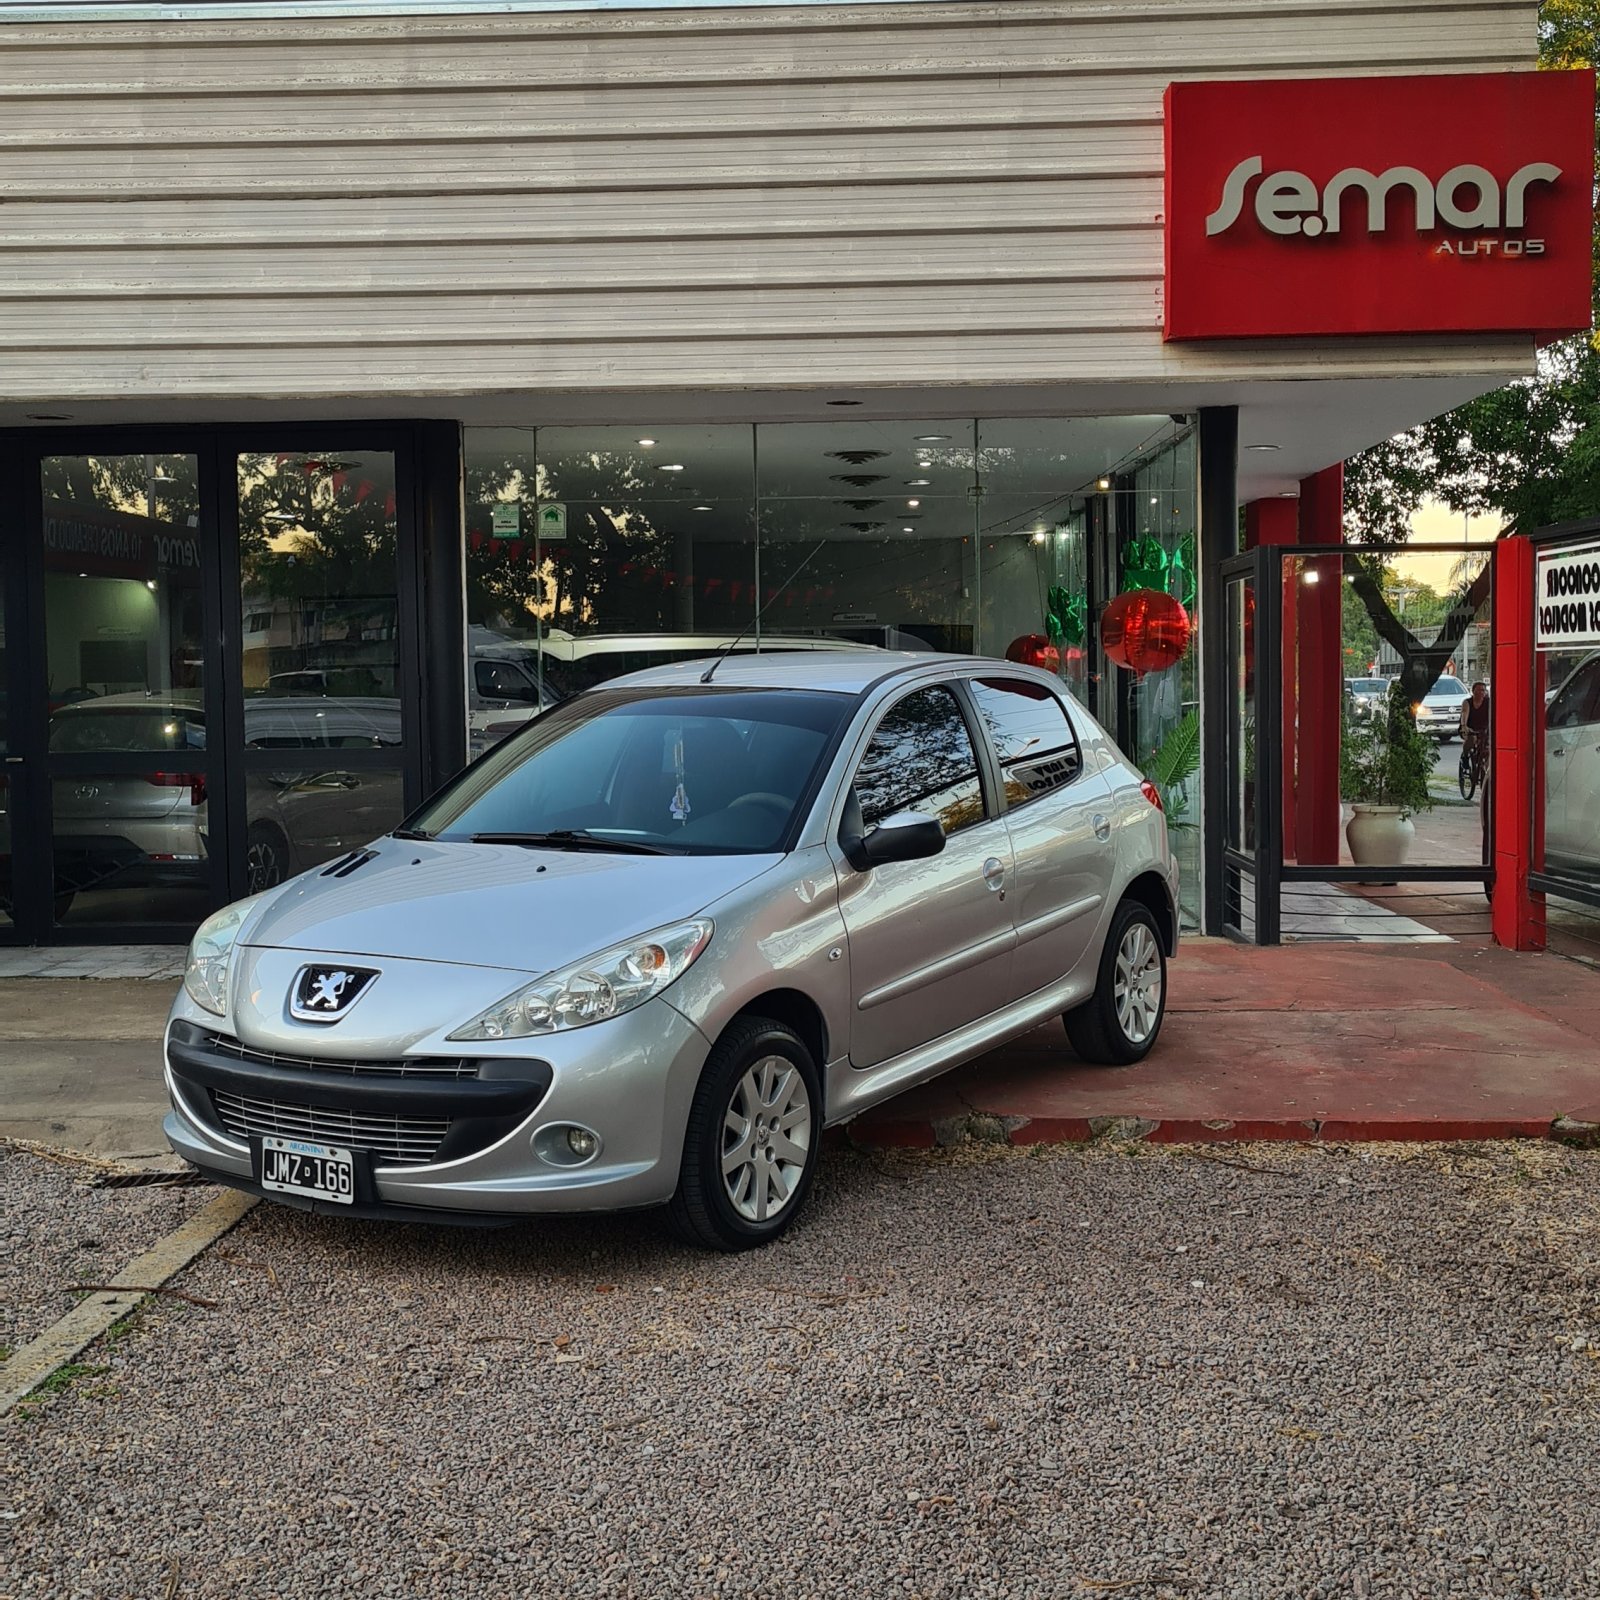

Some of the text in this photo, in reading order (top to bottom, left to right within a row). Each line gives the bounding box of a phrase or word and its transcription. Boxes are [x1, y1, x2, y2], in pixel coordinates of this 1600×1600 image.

[1435, 238, 1545, 255] AUTOS
[289, 1142, 324, 1154] ARGENTINA
[266, 1152, 302, 1185] JMZ
[314, 1159, 350, 1193] 166
